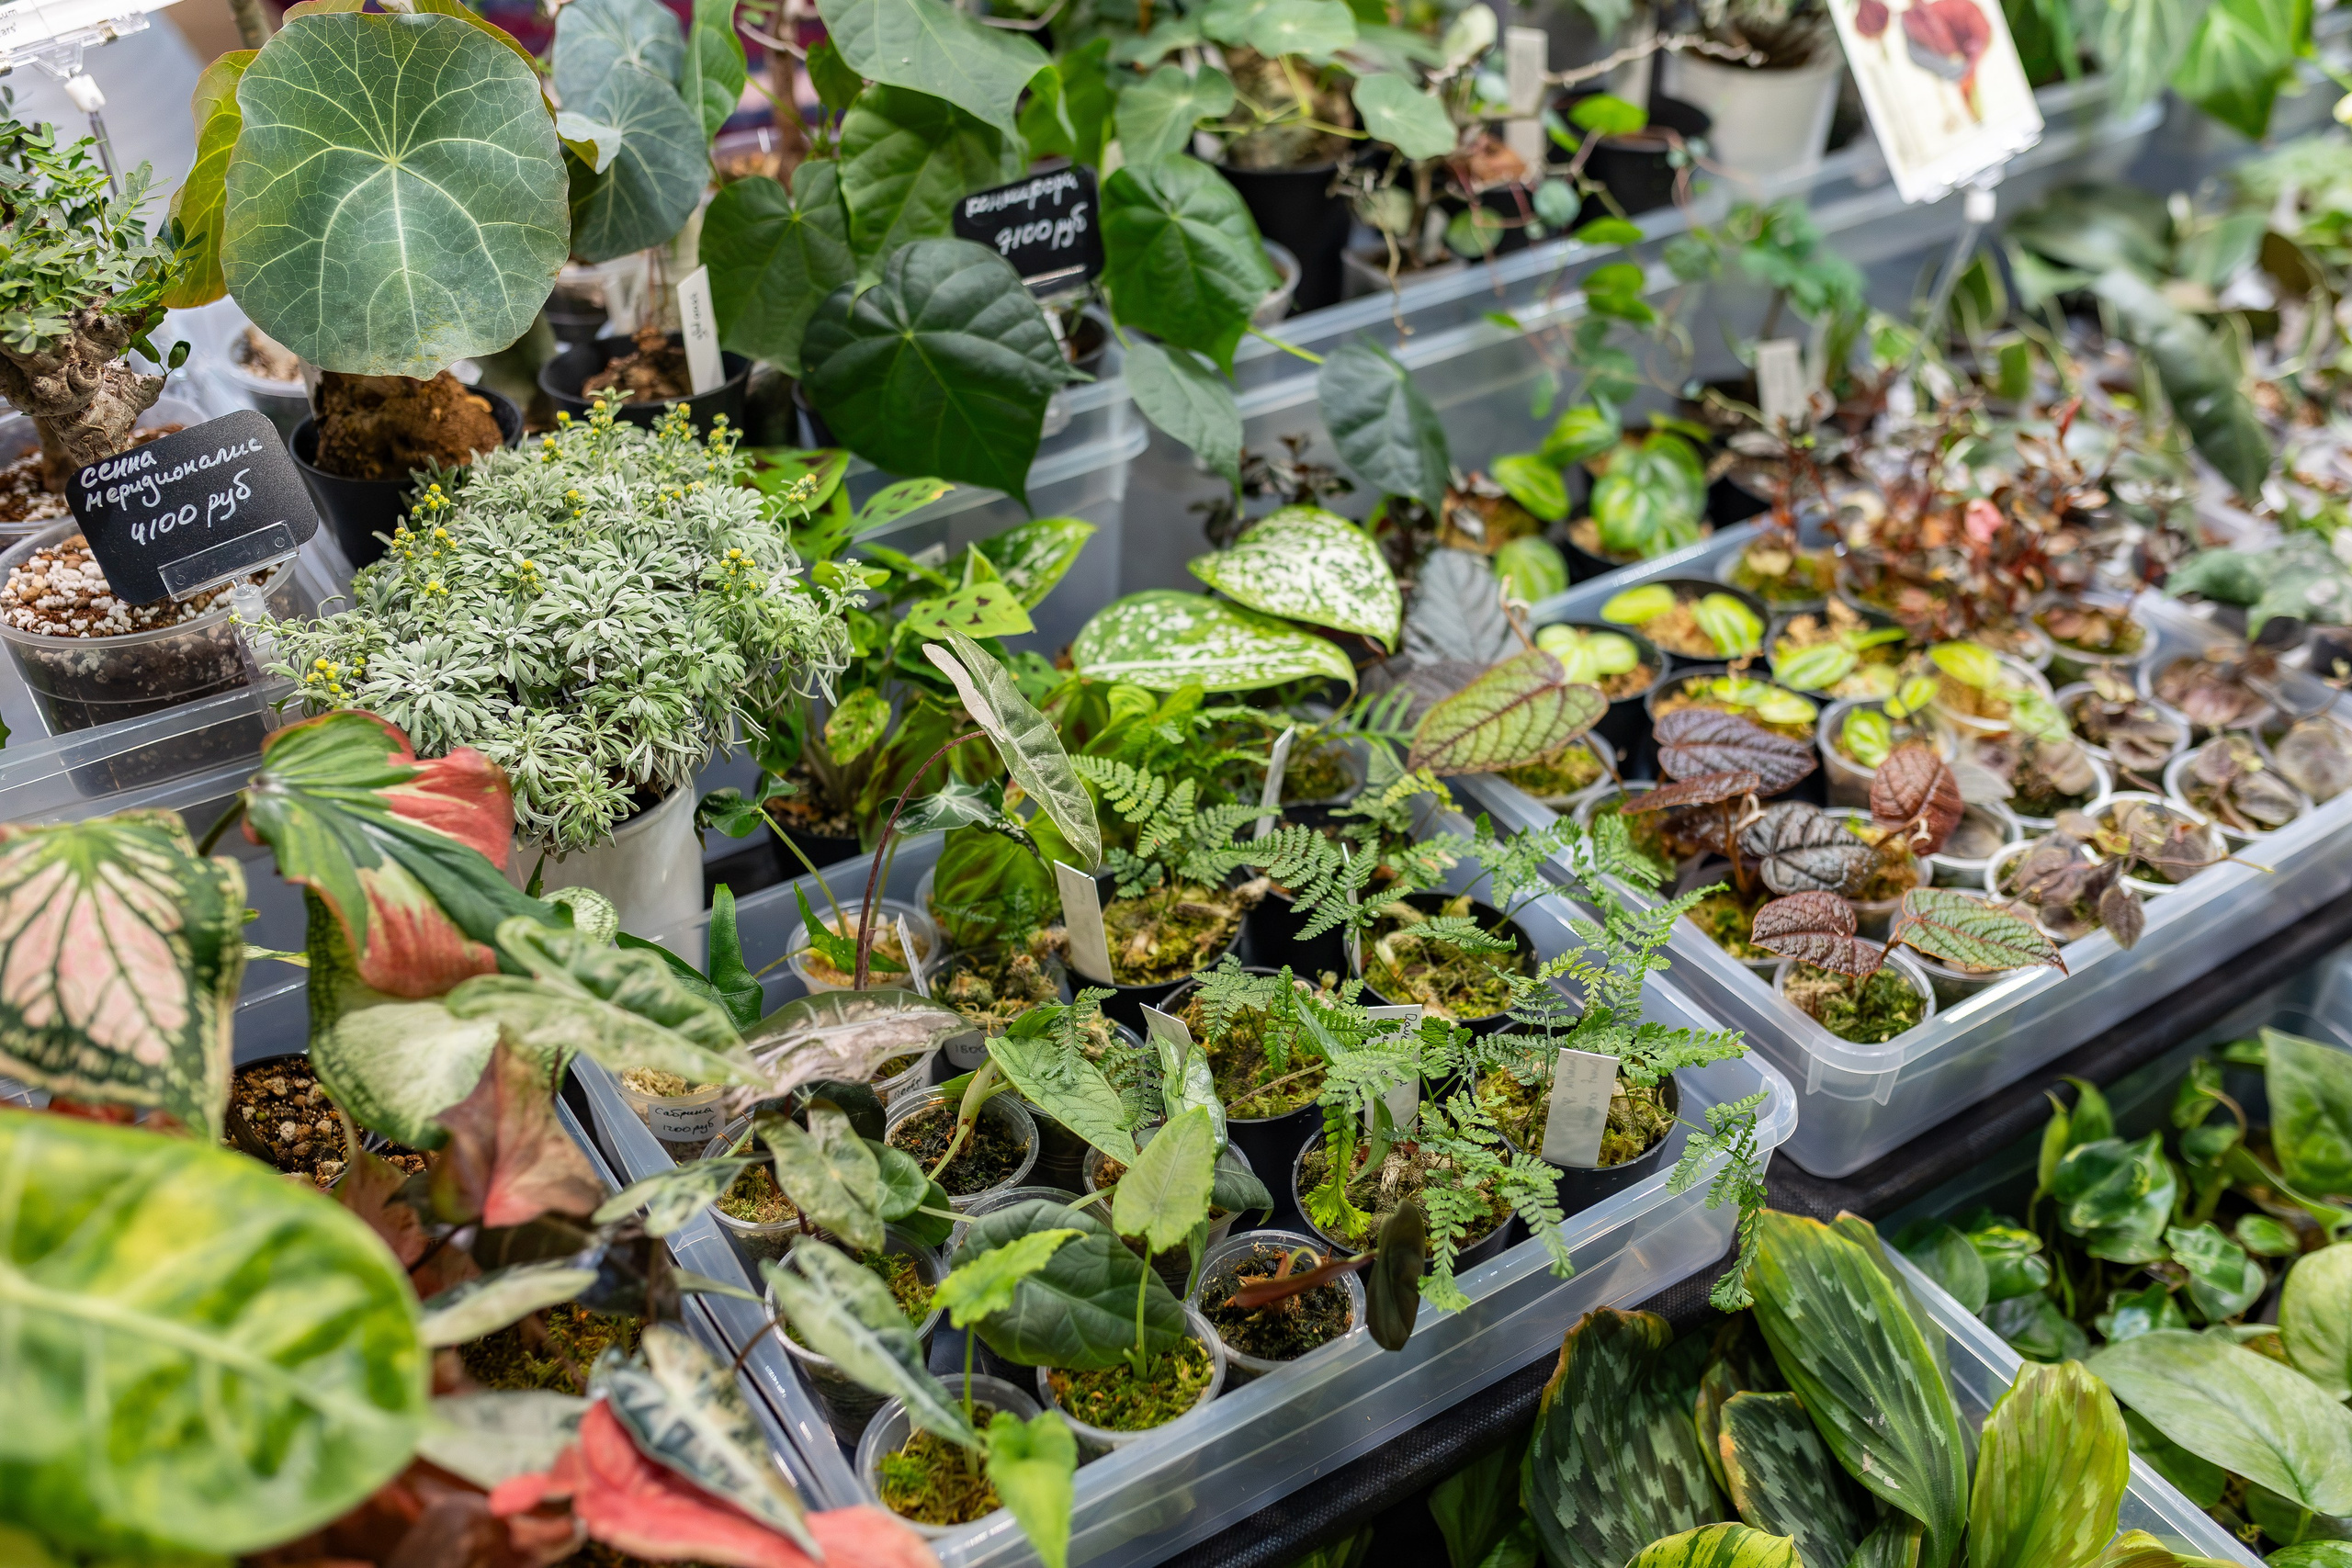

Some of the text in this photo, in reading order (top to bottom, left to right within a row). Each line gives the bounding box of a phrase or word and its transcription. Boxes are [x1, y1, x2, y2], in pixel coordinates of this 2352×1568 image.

[130, 468, 251, 545] 4100 руб
[655, 1107, 715, 1120] Сабрина
